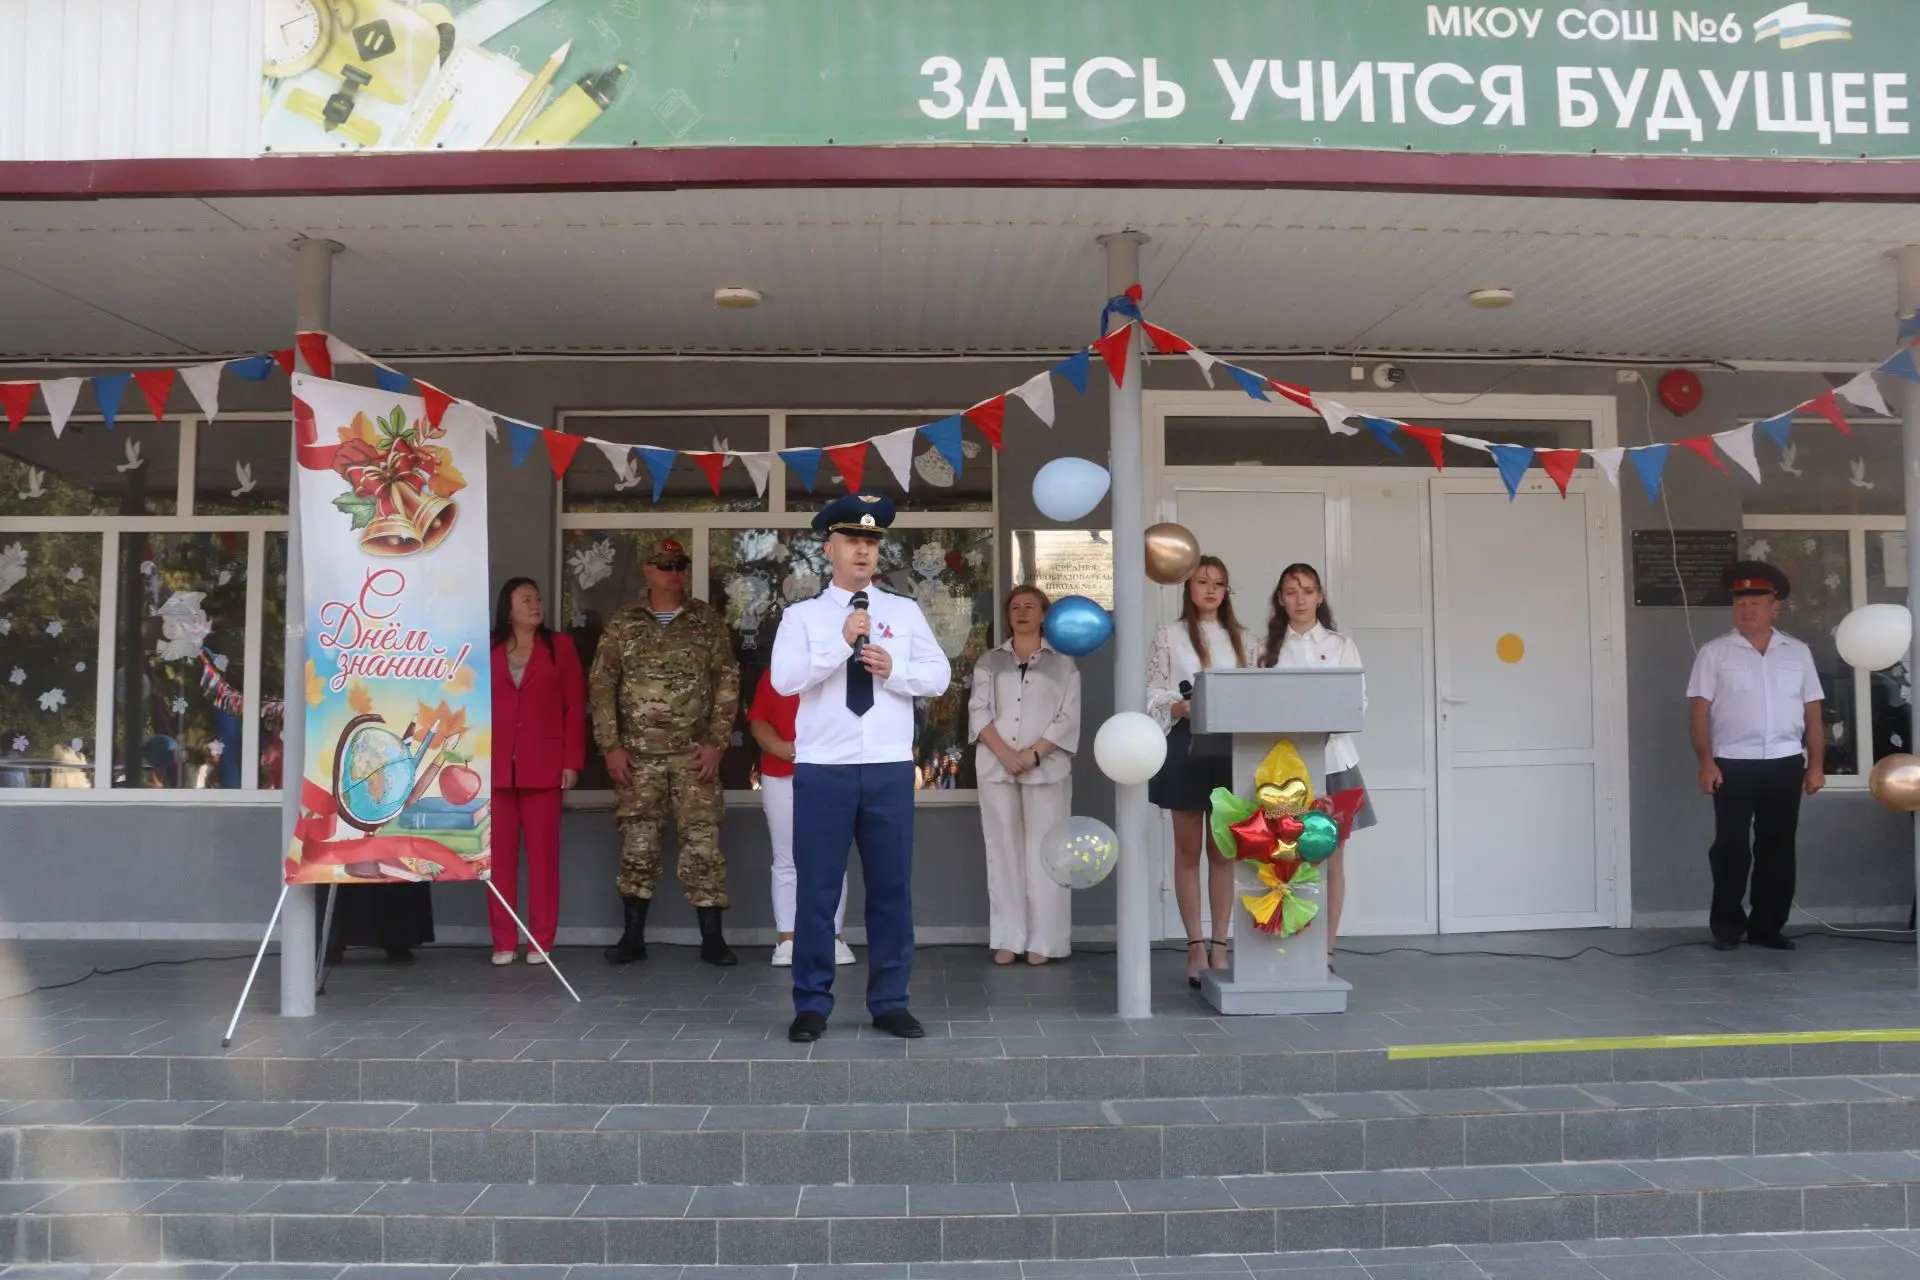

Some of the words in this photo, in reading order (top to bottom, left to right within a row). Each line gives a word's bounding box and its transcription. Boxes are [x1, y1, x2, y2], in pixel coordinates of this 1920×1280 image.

[1426, 5, 1543, 39] МКОУ
[1556, 8, 1659, 42] СОШ
[1672, 10, 1743, 44] №6
[918, 54, 1187, 132] ЗДЕСЬ
[1212, 58, 1526, 127] УЧИТСЯ
[1556, 65, 1910, 145] БУДУЩЕЕ
[359, 566, 406, 619] С
[320, 601, 429, 650] Днём
[330, 644, 471, 691] знаний!
